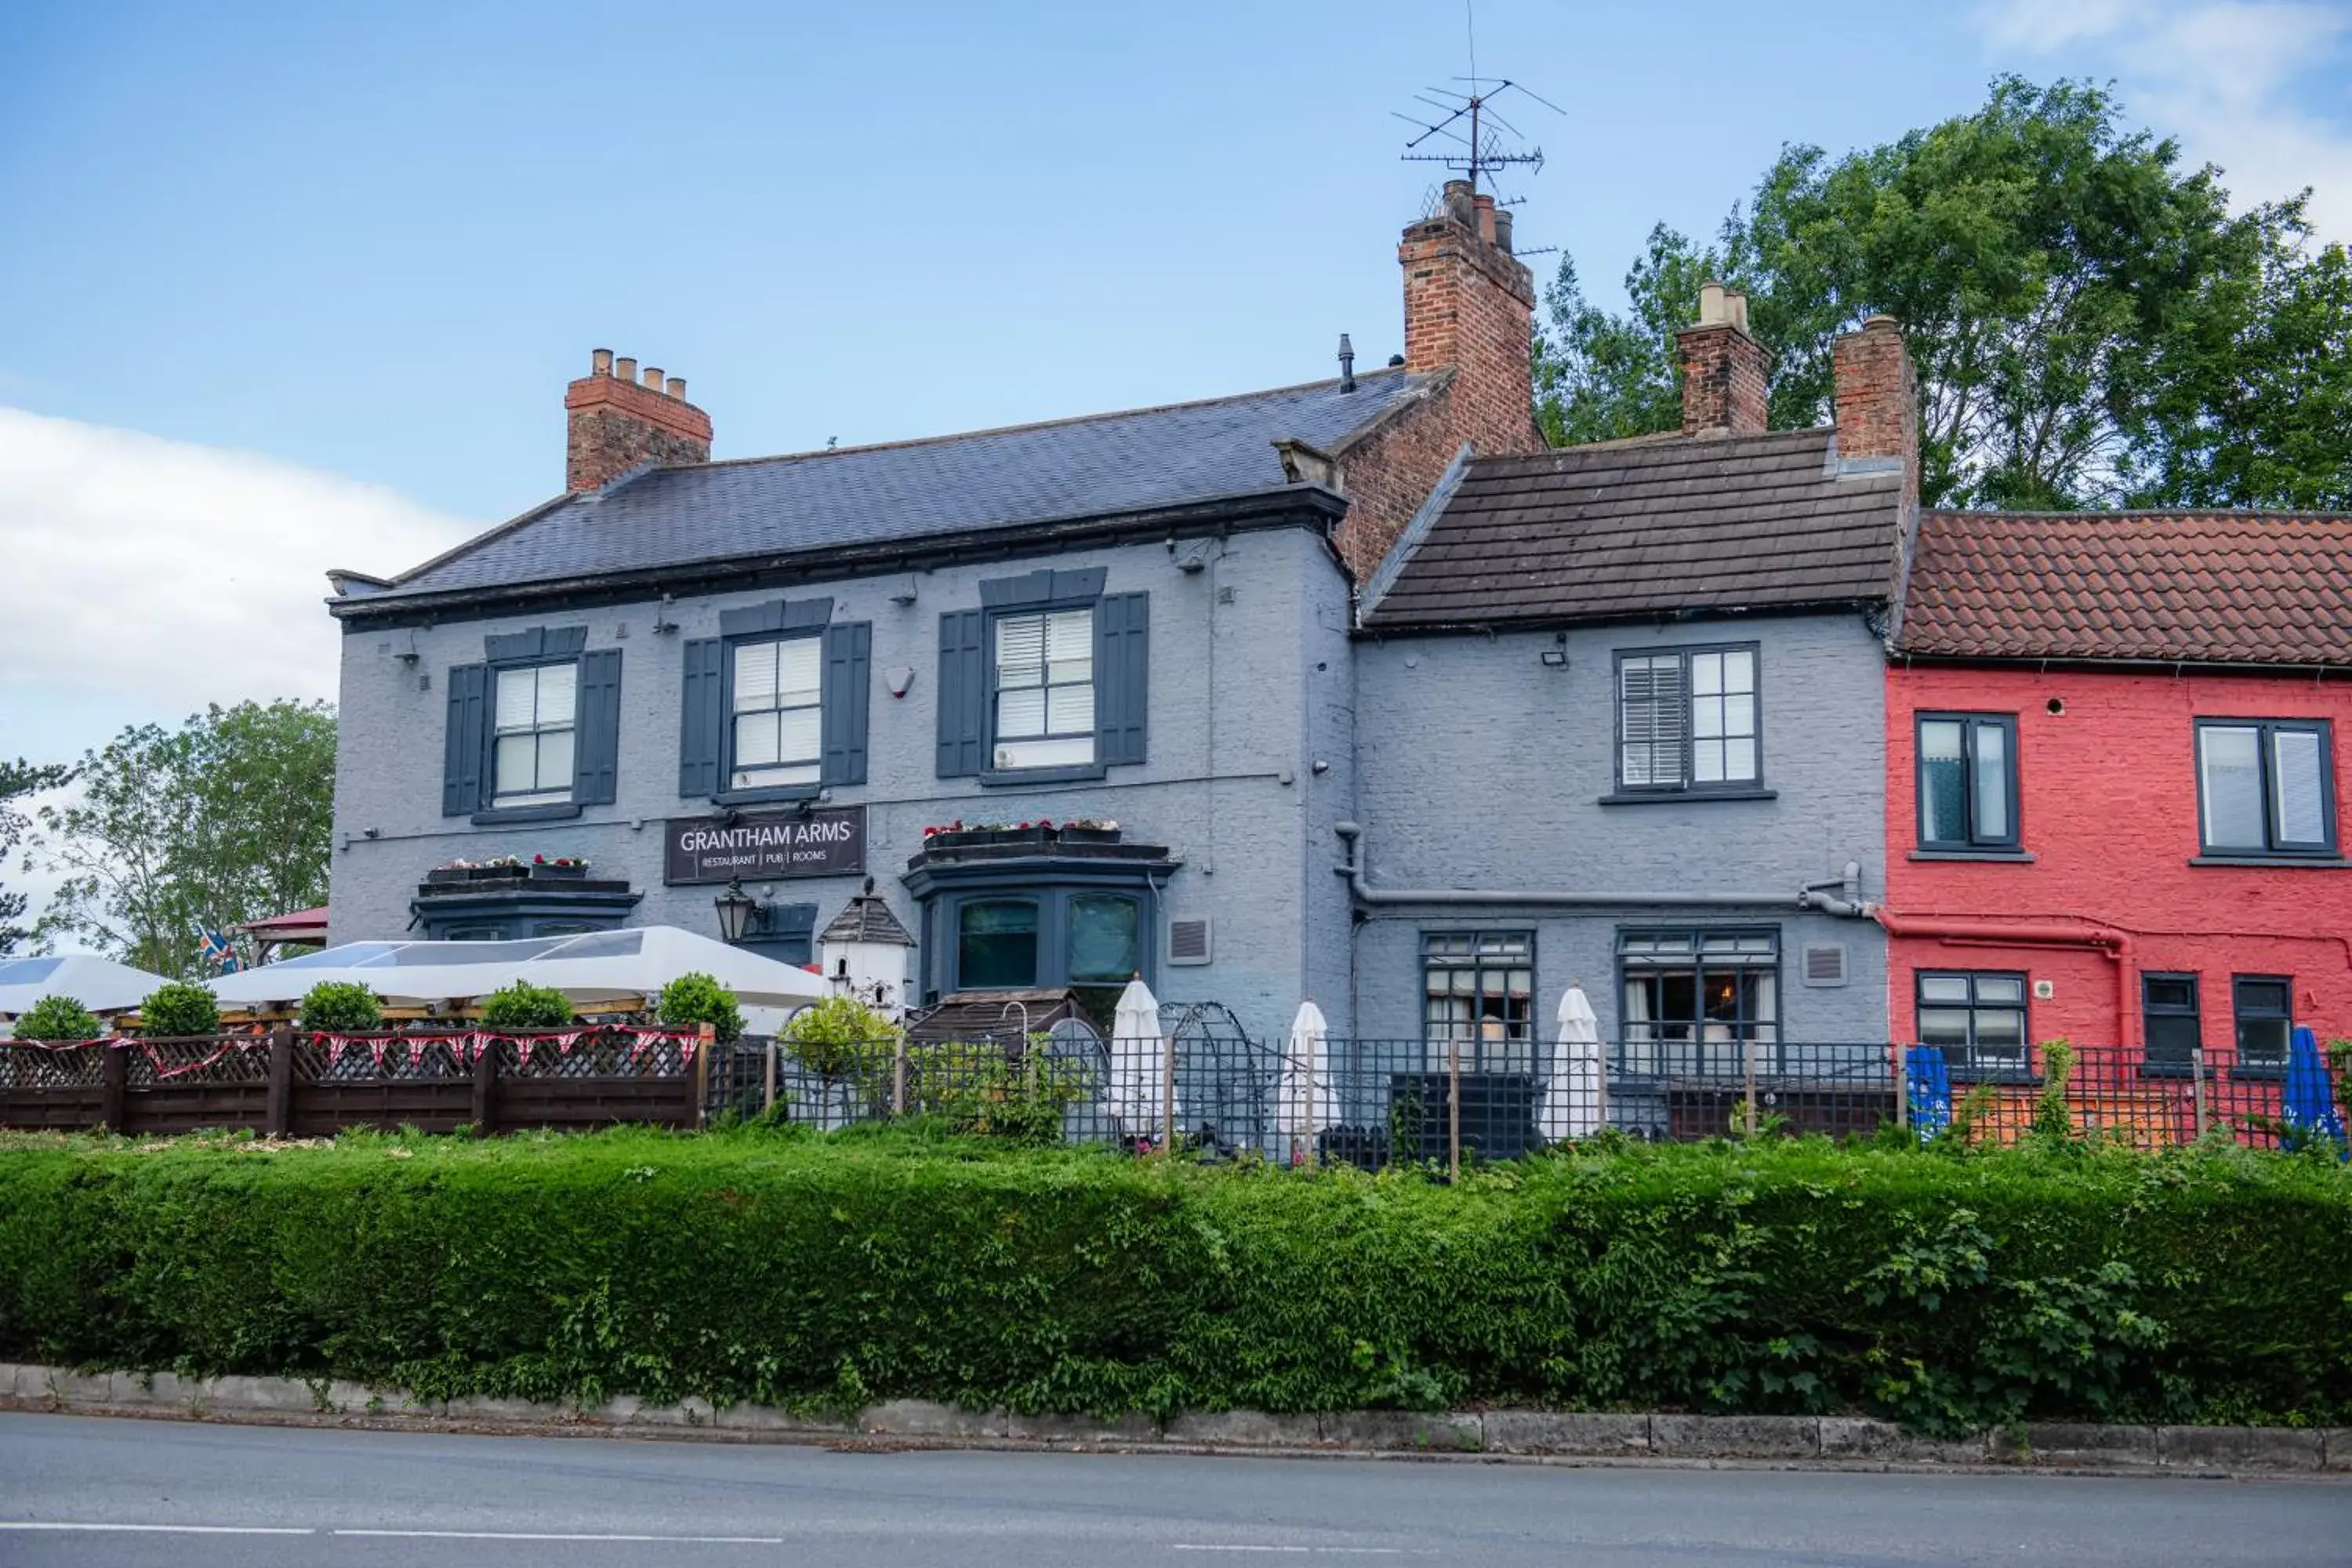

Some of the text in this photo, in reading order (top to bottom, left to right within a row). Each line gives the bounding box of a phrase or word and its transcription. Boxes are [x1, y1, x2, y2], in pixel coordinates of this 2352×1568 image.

[681, 821, 851, 851] GRANTHAM ARMS
[702, 850, 827, 867] RESTAURANT PUB ROOMS
